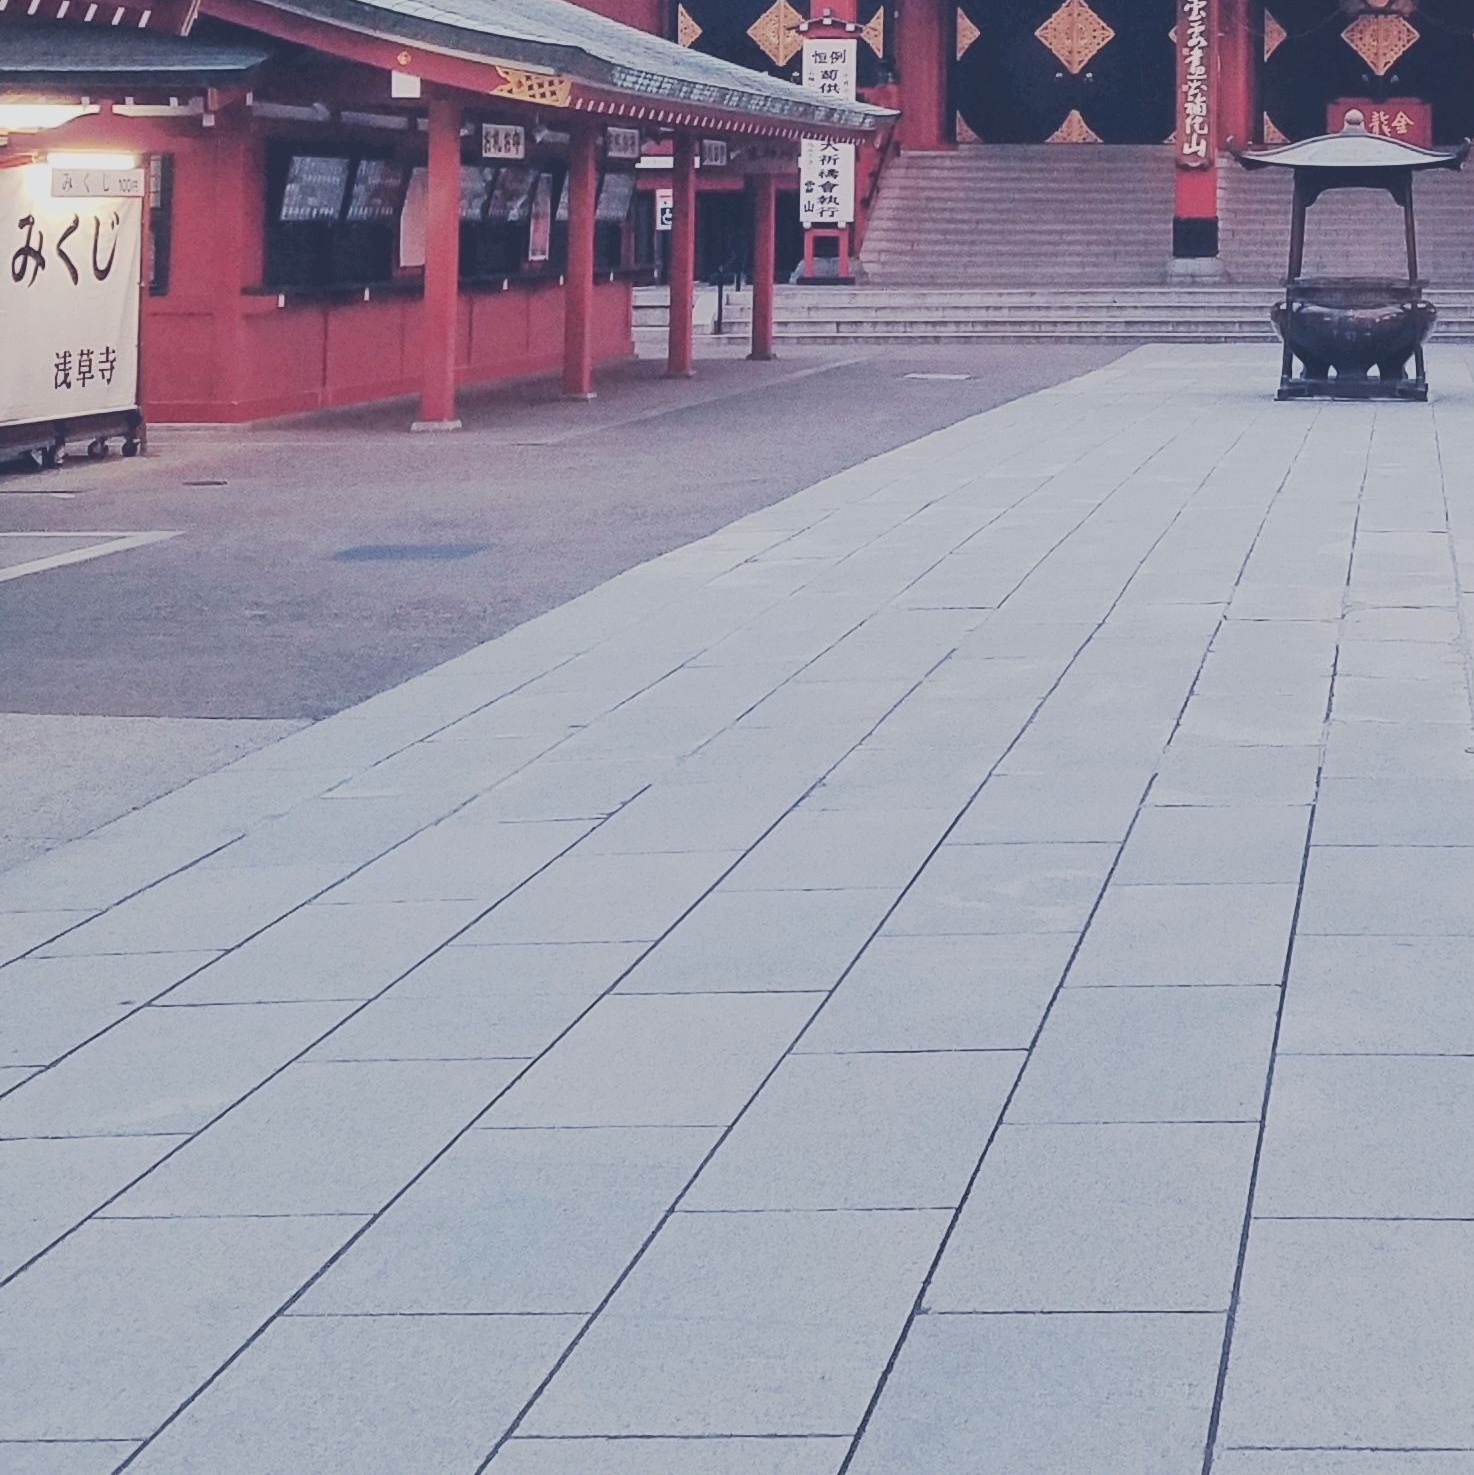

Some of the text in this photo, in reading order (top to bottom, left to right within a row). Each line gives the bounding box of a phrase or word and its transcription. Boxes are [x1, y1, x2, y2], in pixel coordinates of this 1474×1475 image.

[11, 211, 120, 288] みくじ
[53, 346, 117, 390] 浅草寺
